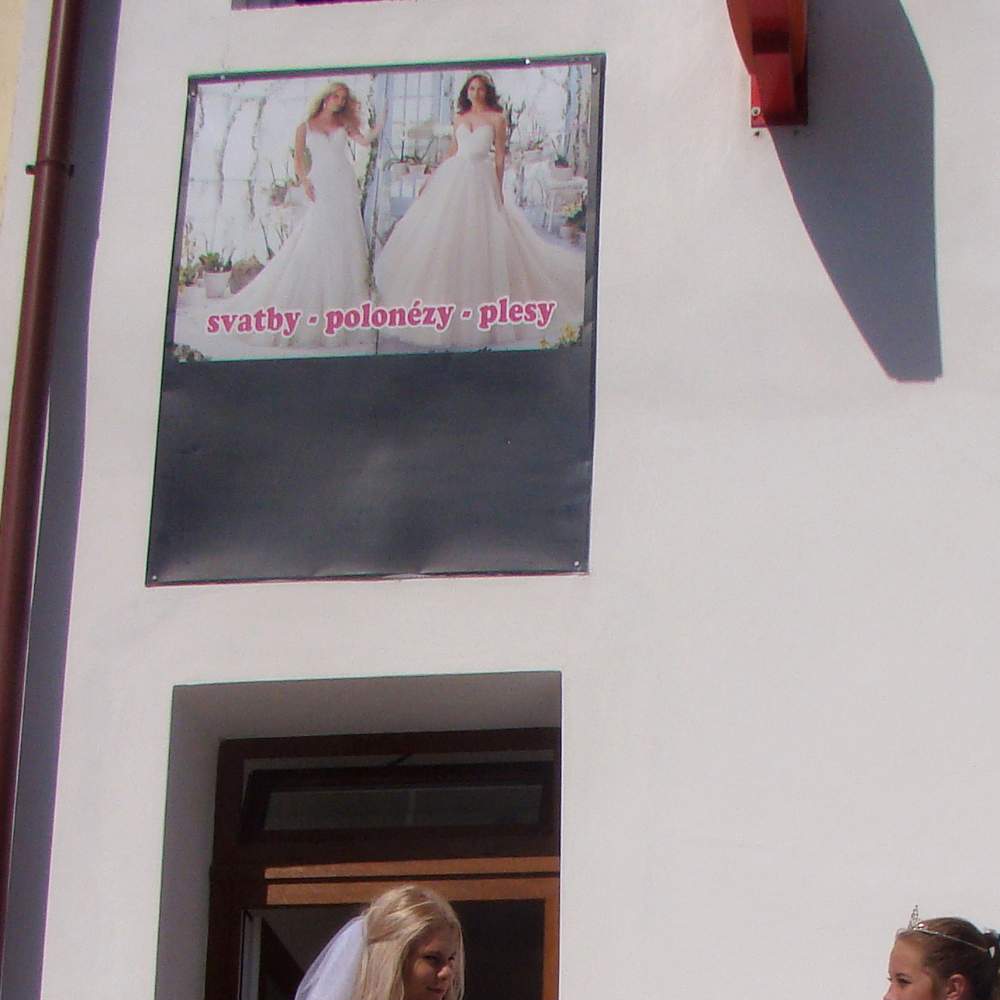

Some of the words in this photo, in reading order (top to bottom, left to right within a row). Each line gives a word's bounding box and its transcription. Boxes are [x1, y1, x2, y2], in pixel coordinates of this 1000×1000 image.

[206, 307, 300, 336] svatby
[325, 301, 453, 335] polonézy
[478, 297, 554, 328] plesy
